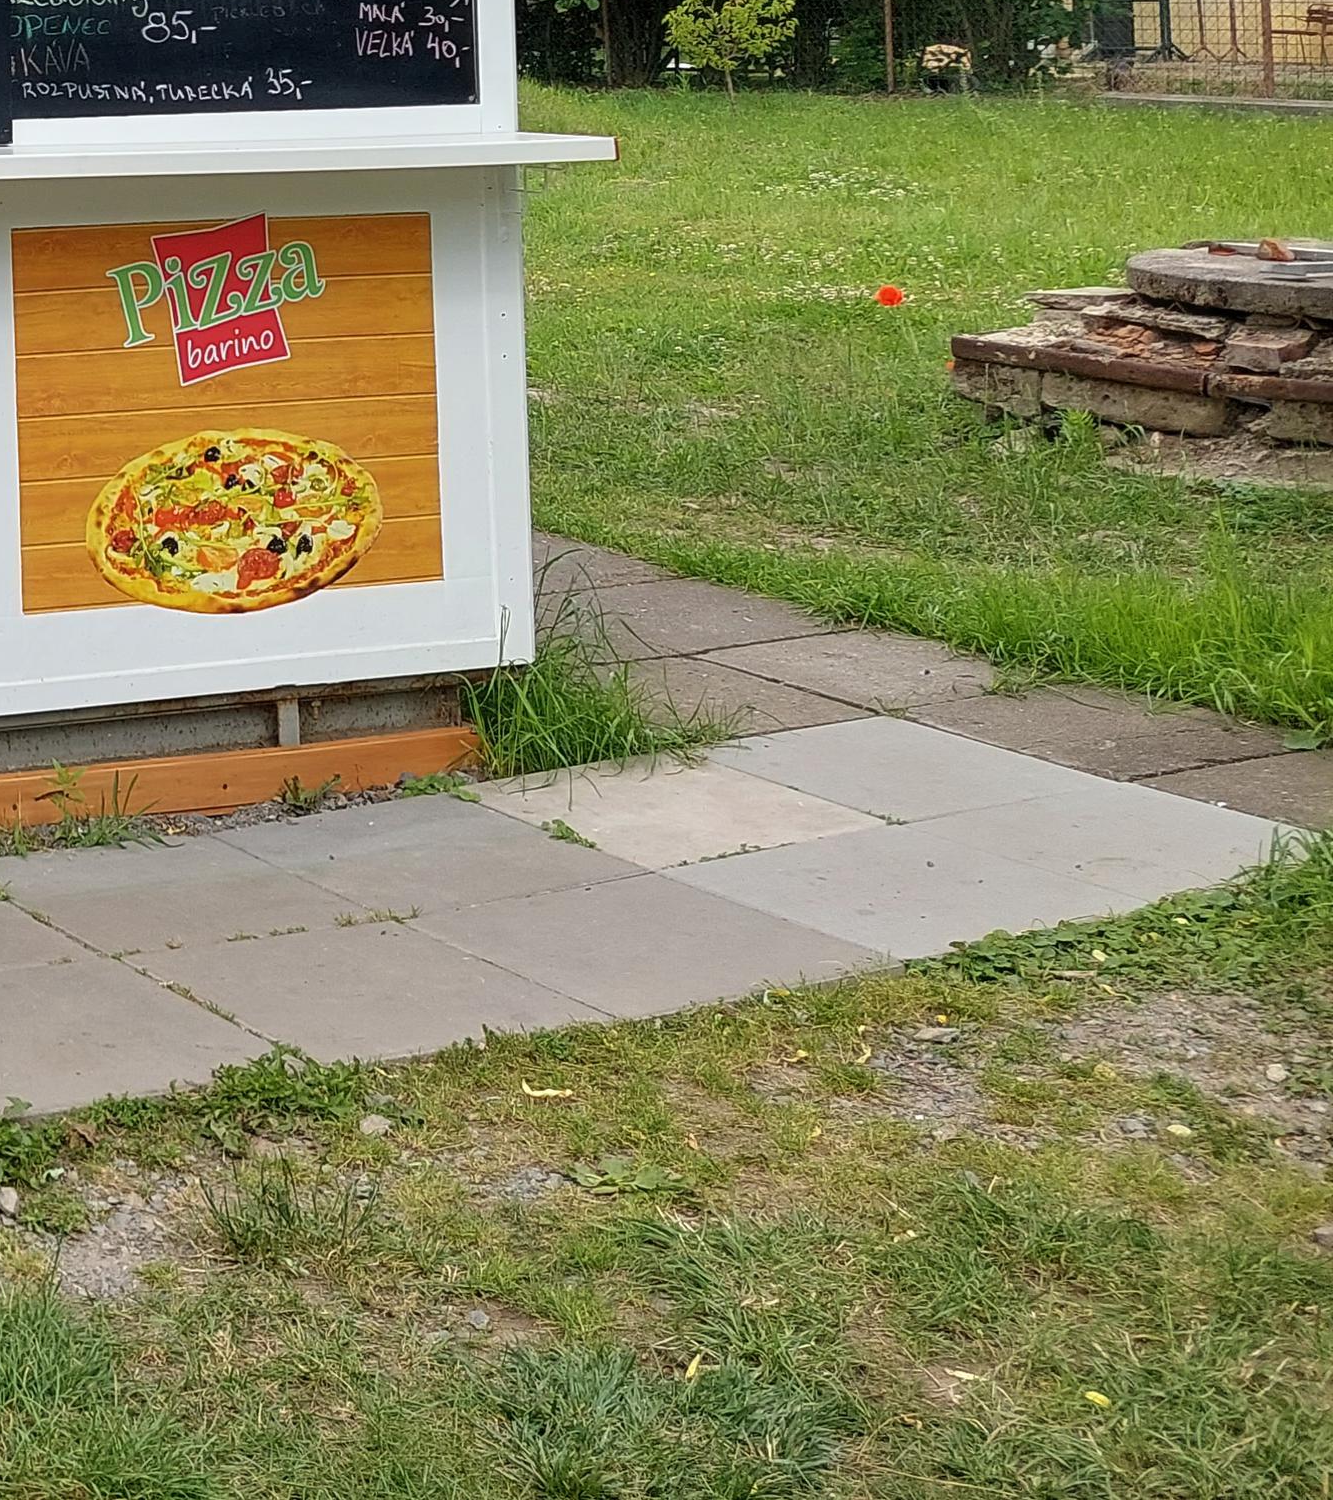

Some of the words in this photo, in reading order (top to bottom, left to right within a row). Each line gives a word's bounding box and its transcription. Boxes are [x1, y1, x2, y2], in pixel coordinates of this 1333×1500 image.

[359, 2, 406, 25] MALÁ
[355, 27, 416, 58] VELKÁ
[155, 76, 254, 101] TURECKÁ
[106, 241, 325, 348] Pizza
[187, 329, 274, 369] barino
